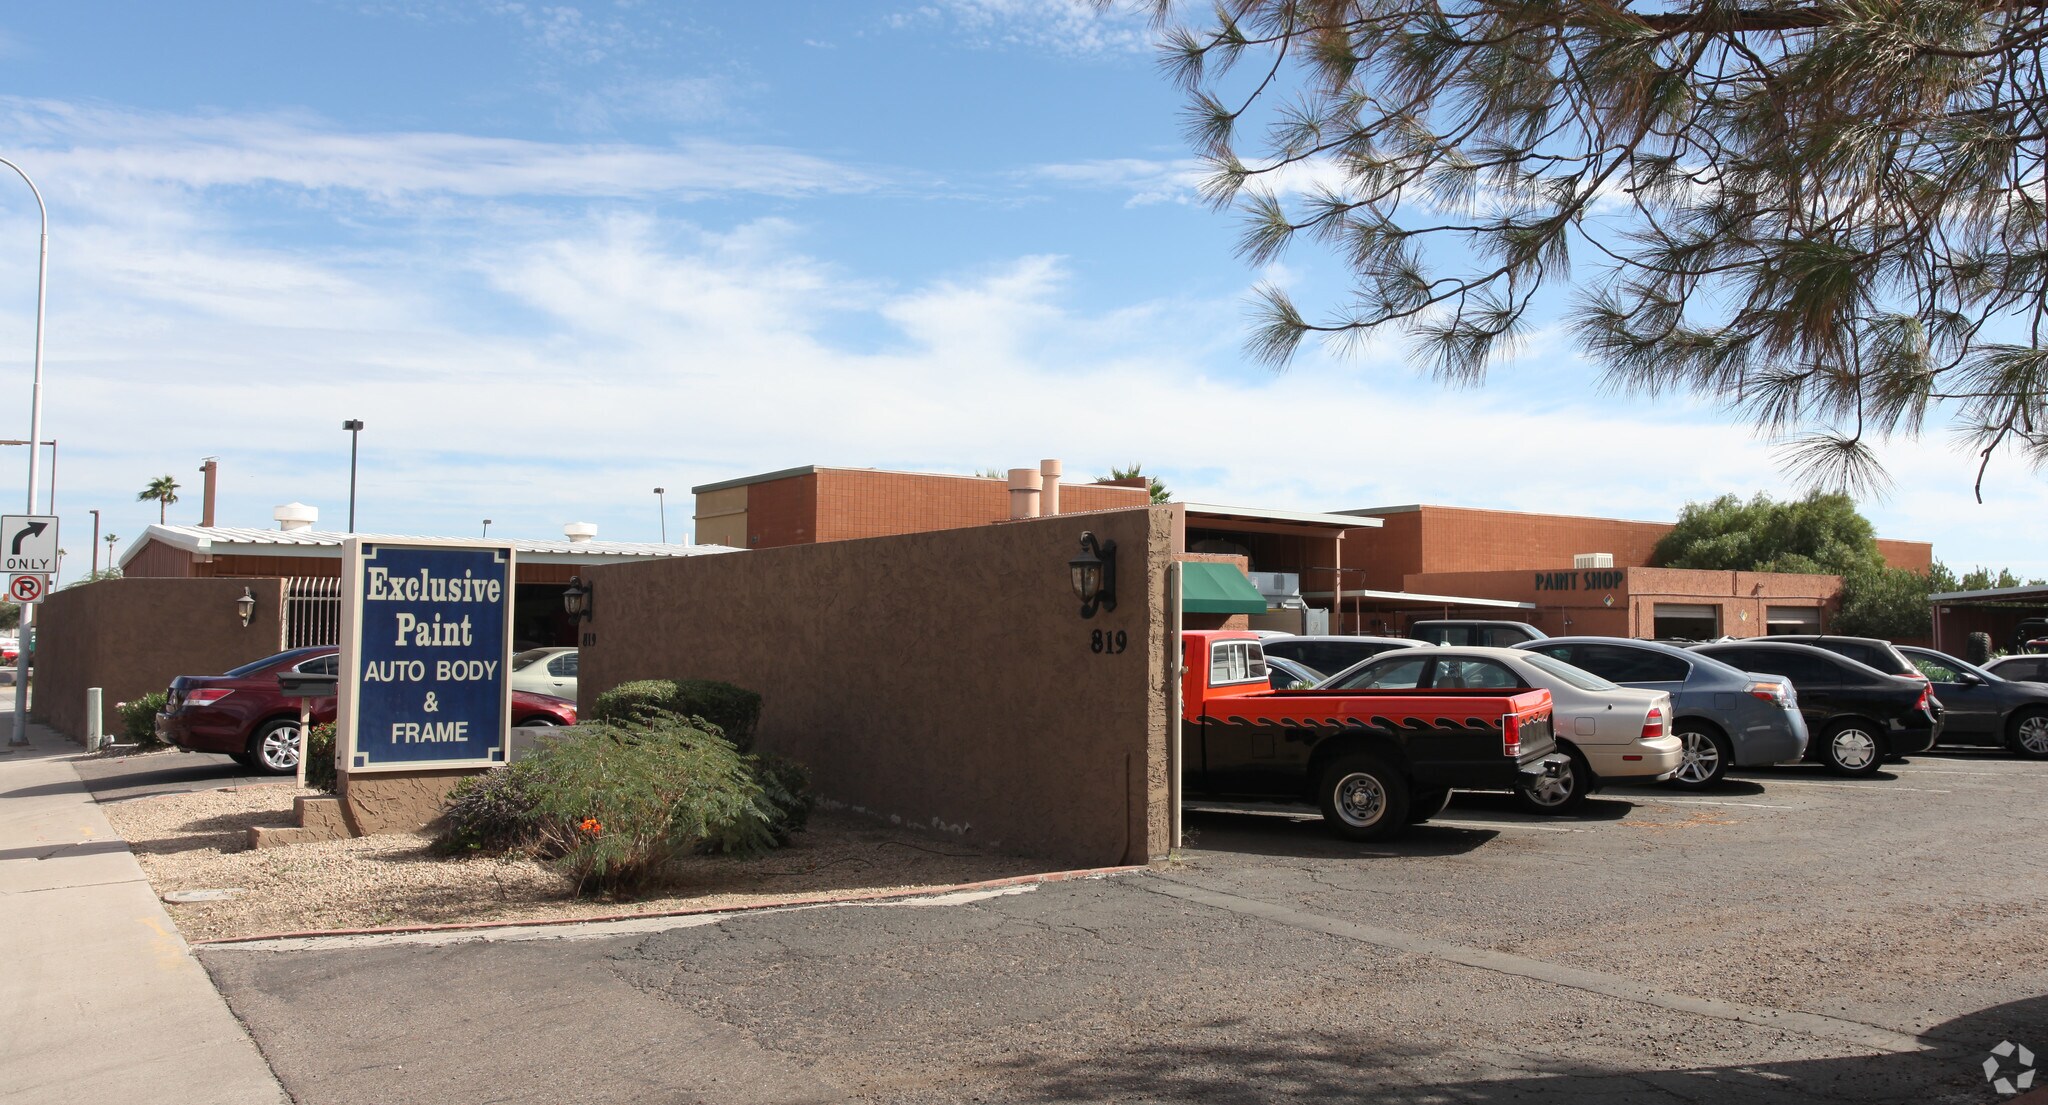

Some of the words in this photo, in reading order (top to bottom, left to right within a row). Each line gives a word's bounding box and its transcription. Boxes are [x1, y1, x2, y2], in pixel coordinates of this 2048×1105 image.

[7, 559, 49, 570] ONLY
[367, 567, 501, 603] Exclusive
[1535, 572, 1578, 591] PAINT
[1583, 570, 1623, 591] SHOP
[395, 612, 473, 647] Paint
[1091, 629, 1127, 655] 819
[364, 660, 425, 682] AUTO
[436, 660, 498, 681] BODY
[423, 691, 439, 712] &
[391, 721, 468, 744] FRAME
